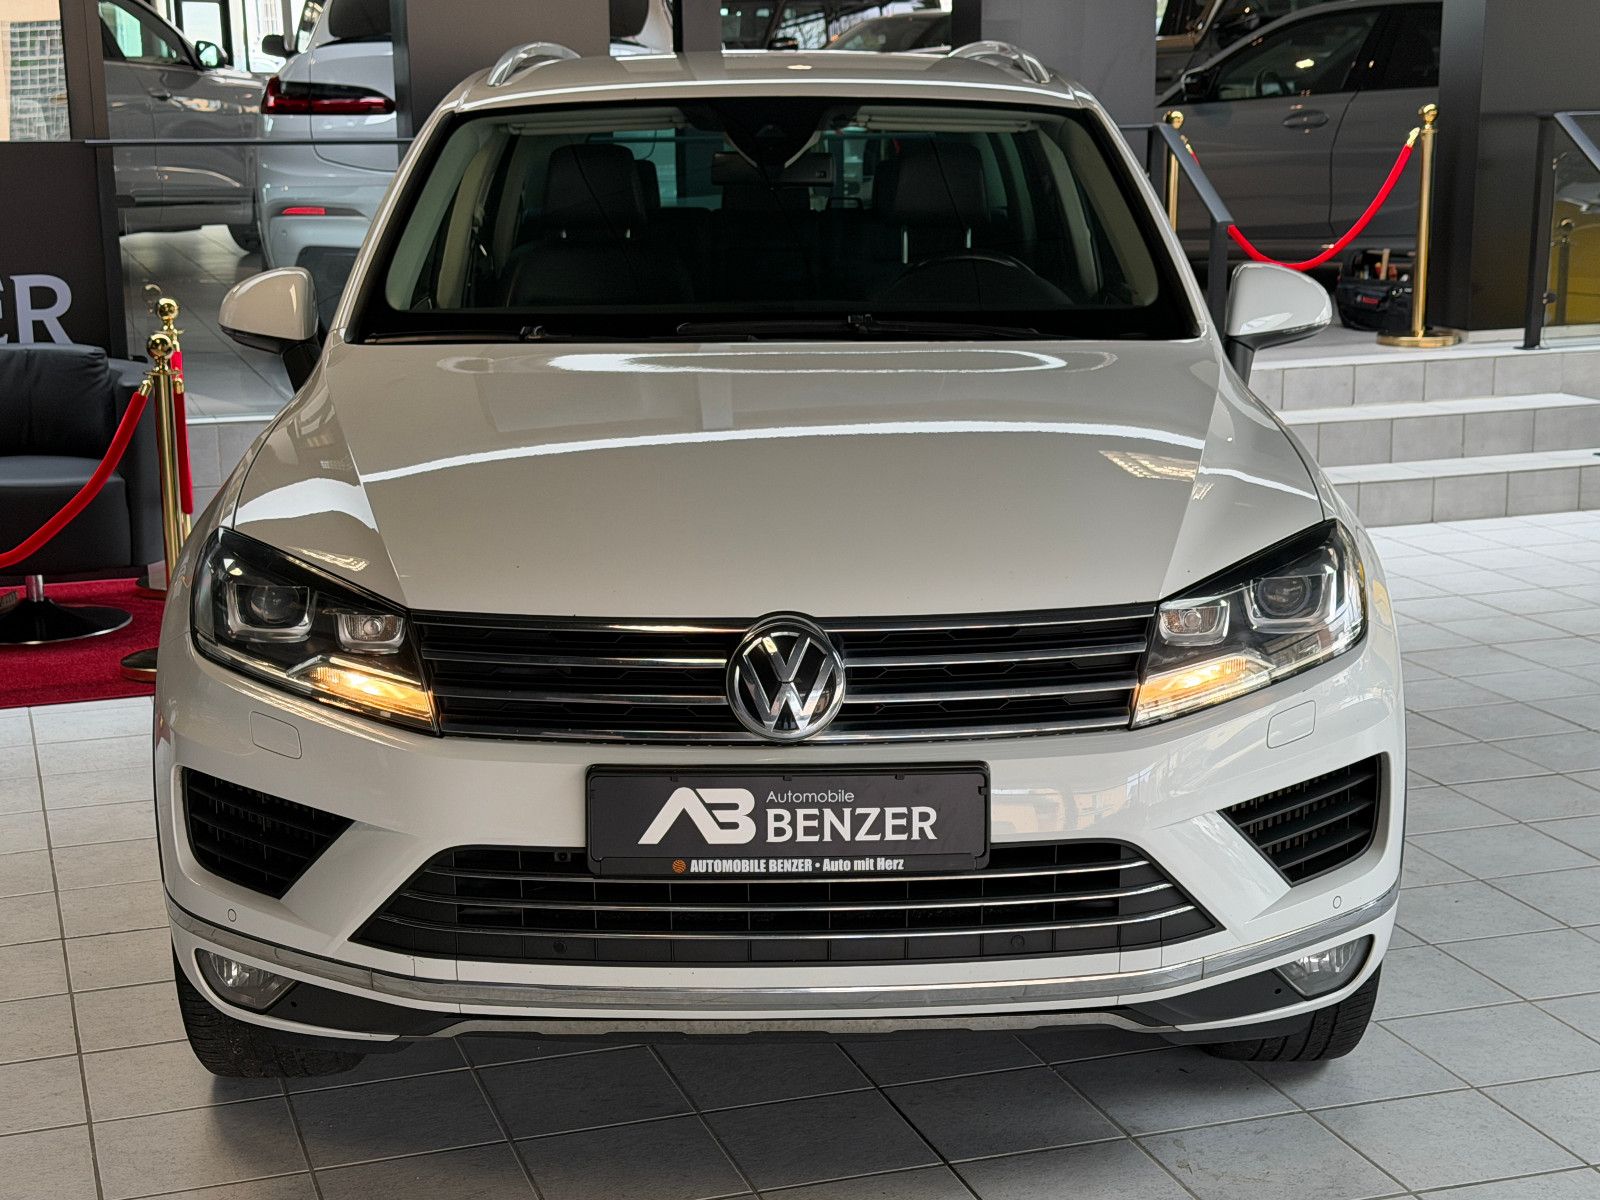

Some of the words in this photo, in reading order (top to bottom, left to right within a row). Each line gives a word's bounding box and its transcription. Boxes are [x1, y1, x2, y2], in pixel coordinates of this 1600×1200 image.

[0, 274, 74, 344] R
[766, 789, 855, 804] Automobile
[765, 806, 938, 843] BENZER
[690, 858, 767, 873] AUTOMOBILE
[768, 858, 813, 873] BENZER
[823, 858, 851, 872] Auto
[853, 857, 875, 872] mit
[876, 856, 905, 871] Herz
